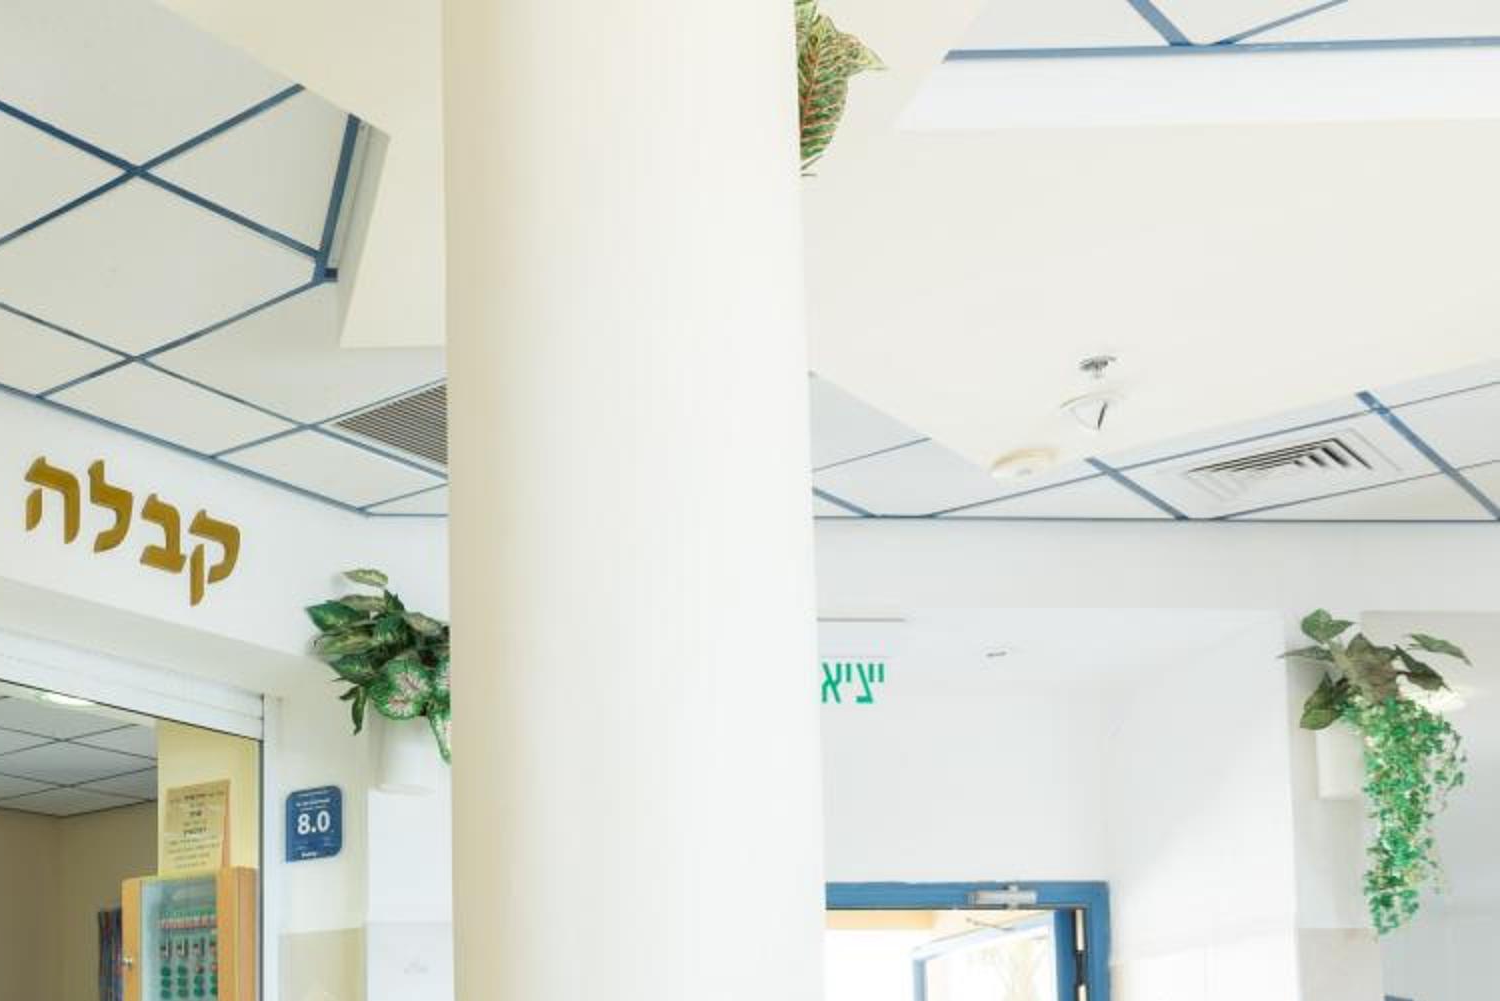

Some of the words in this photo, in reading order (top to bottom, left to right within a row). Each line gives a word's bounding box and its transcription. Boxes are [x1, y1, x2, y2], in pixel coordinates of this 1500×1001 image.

[24, 457, 242, 606] קבלה
[820, 661, 885, 704] יציא
[297, 810, 331, 835] 8.0
